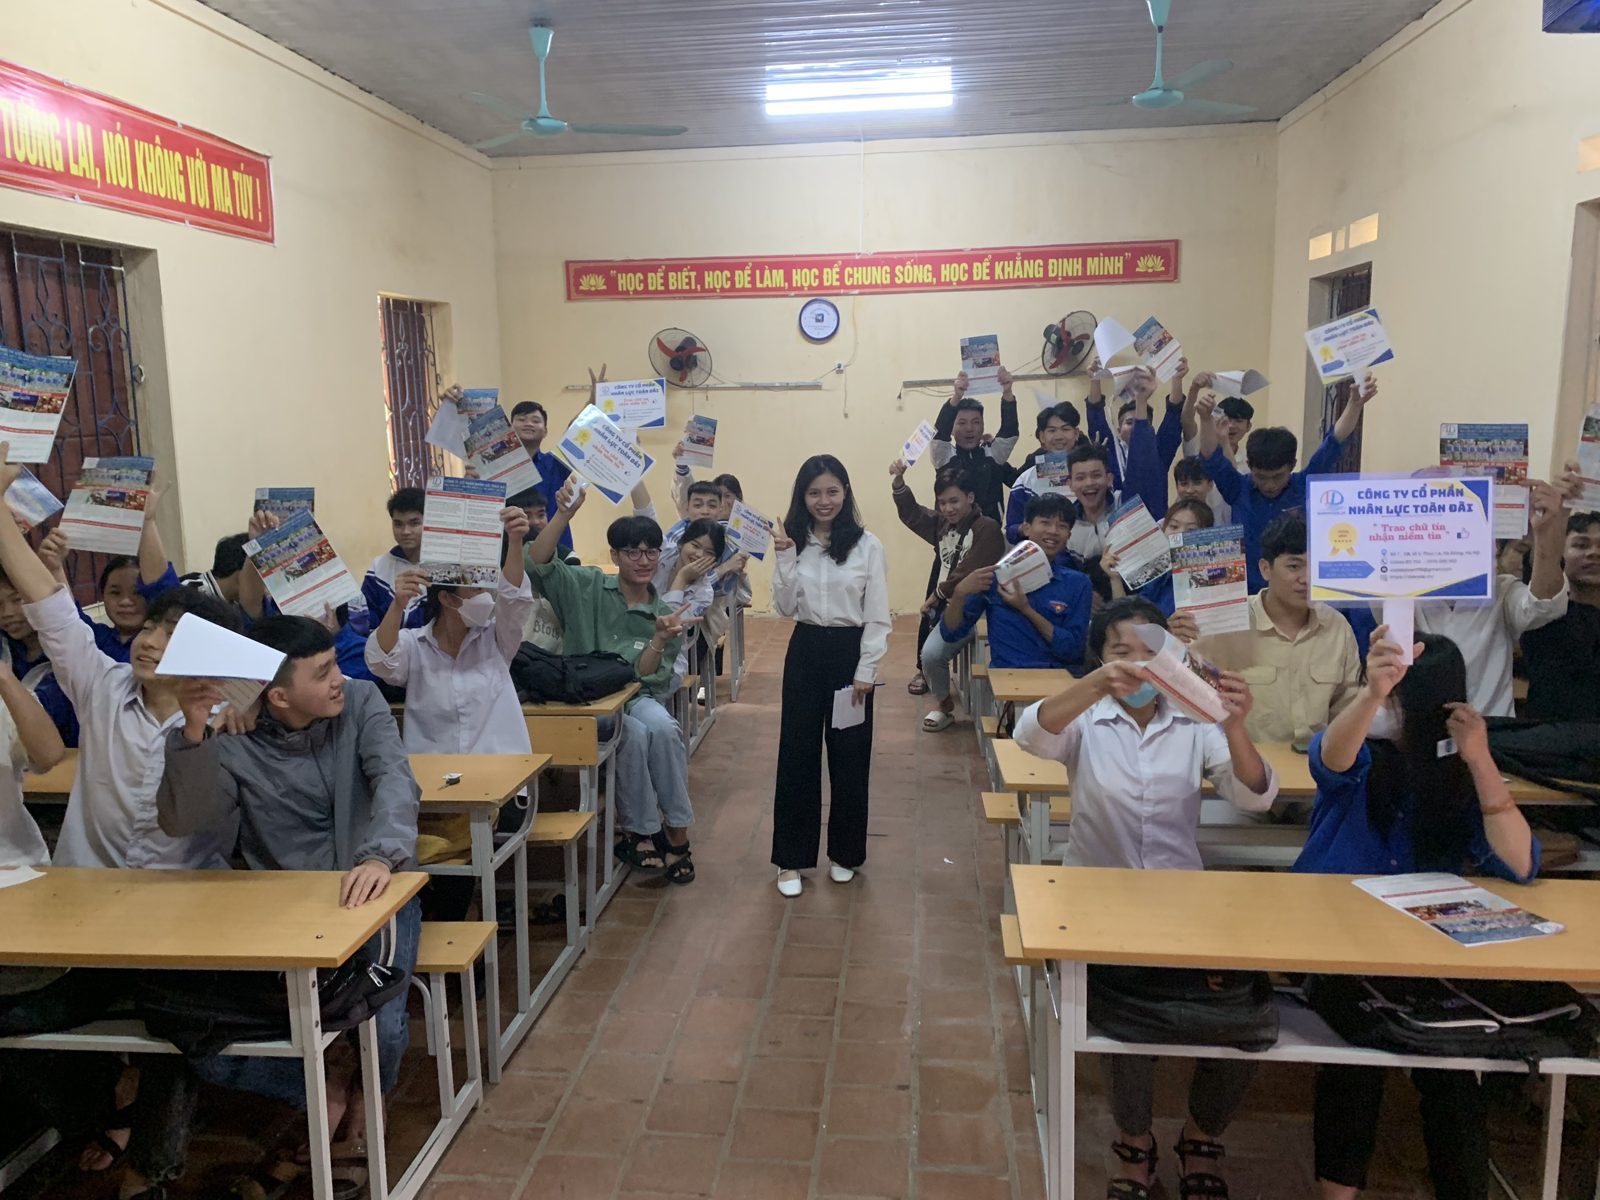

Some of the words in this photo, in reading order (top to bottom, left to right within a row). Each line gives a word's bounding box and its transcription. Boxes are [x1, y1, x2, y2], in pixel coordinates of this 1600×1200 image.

[65, 117, 102, 189] LAI,
[102, 121, 133, 190] NÓI
[134, 134, 186, 203] KHÔNG
[186, 147, 210, 209] VỚI
[210, 163, 234, 216] MA
[232, 162, 254, 221] TÚY
[647, 265, 665, 290] ĐỂ
[668, 265, 701, 292] BIẾT,
[704, 270, 731, 293] HỌC
[734, 262, 752, 288] ĐỂ
[755, 265, 789, 290] LÀM,
[792, 268, 819, 291] HỌC
[823, 260, 842, 286] ĐỂ
[844, 265, 891, 286] CHUNG
[895, 258, 937, 285] SỐNG,
[941, 263, 969, 286] HỌC
[973, 254, 992, 281] ĐỂ
[994, 251, 1044, 280] KHẲNG
[1048, 257, 1082, 281] ĐỊNH
[1357, 488, 1390, 500] CÔNG
[1393, 489, 1409, 499] TY
[1411, 483, 1427, 499] CỔ
[1430, 483, 1464, 498] PHẦN
[1348, 503, 1383, 515] NHÂN
[1386, 504, 1410, 517] LỰC
